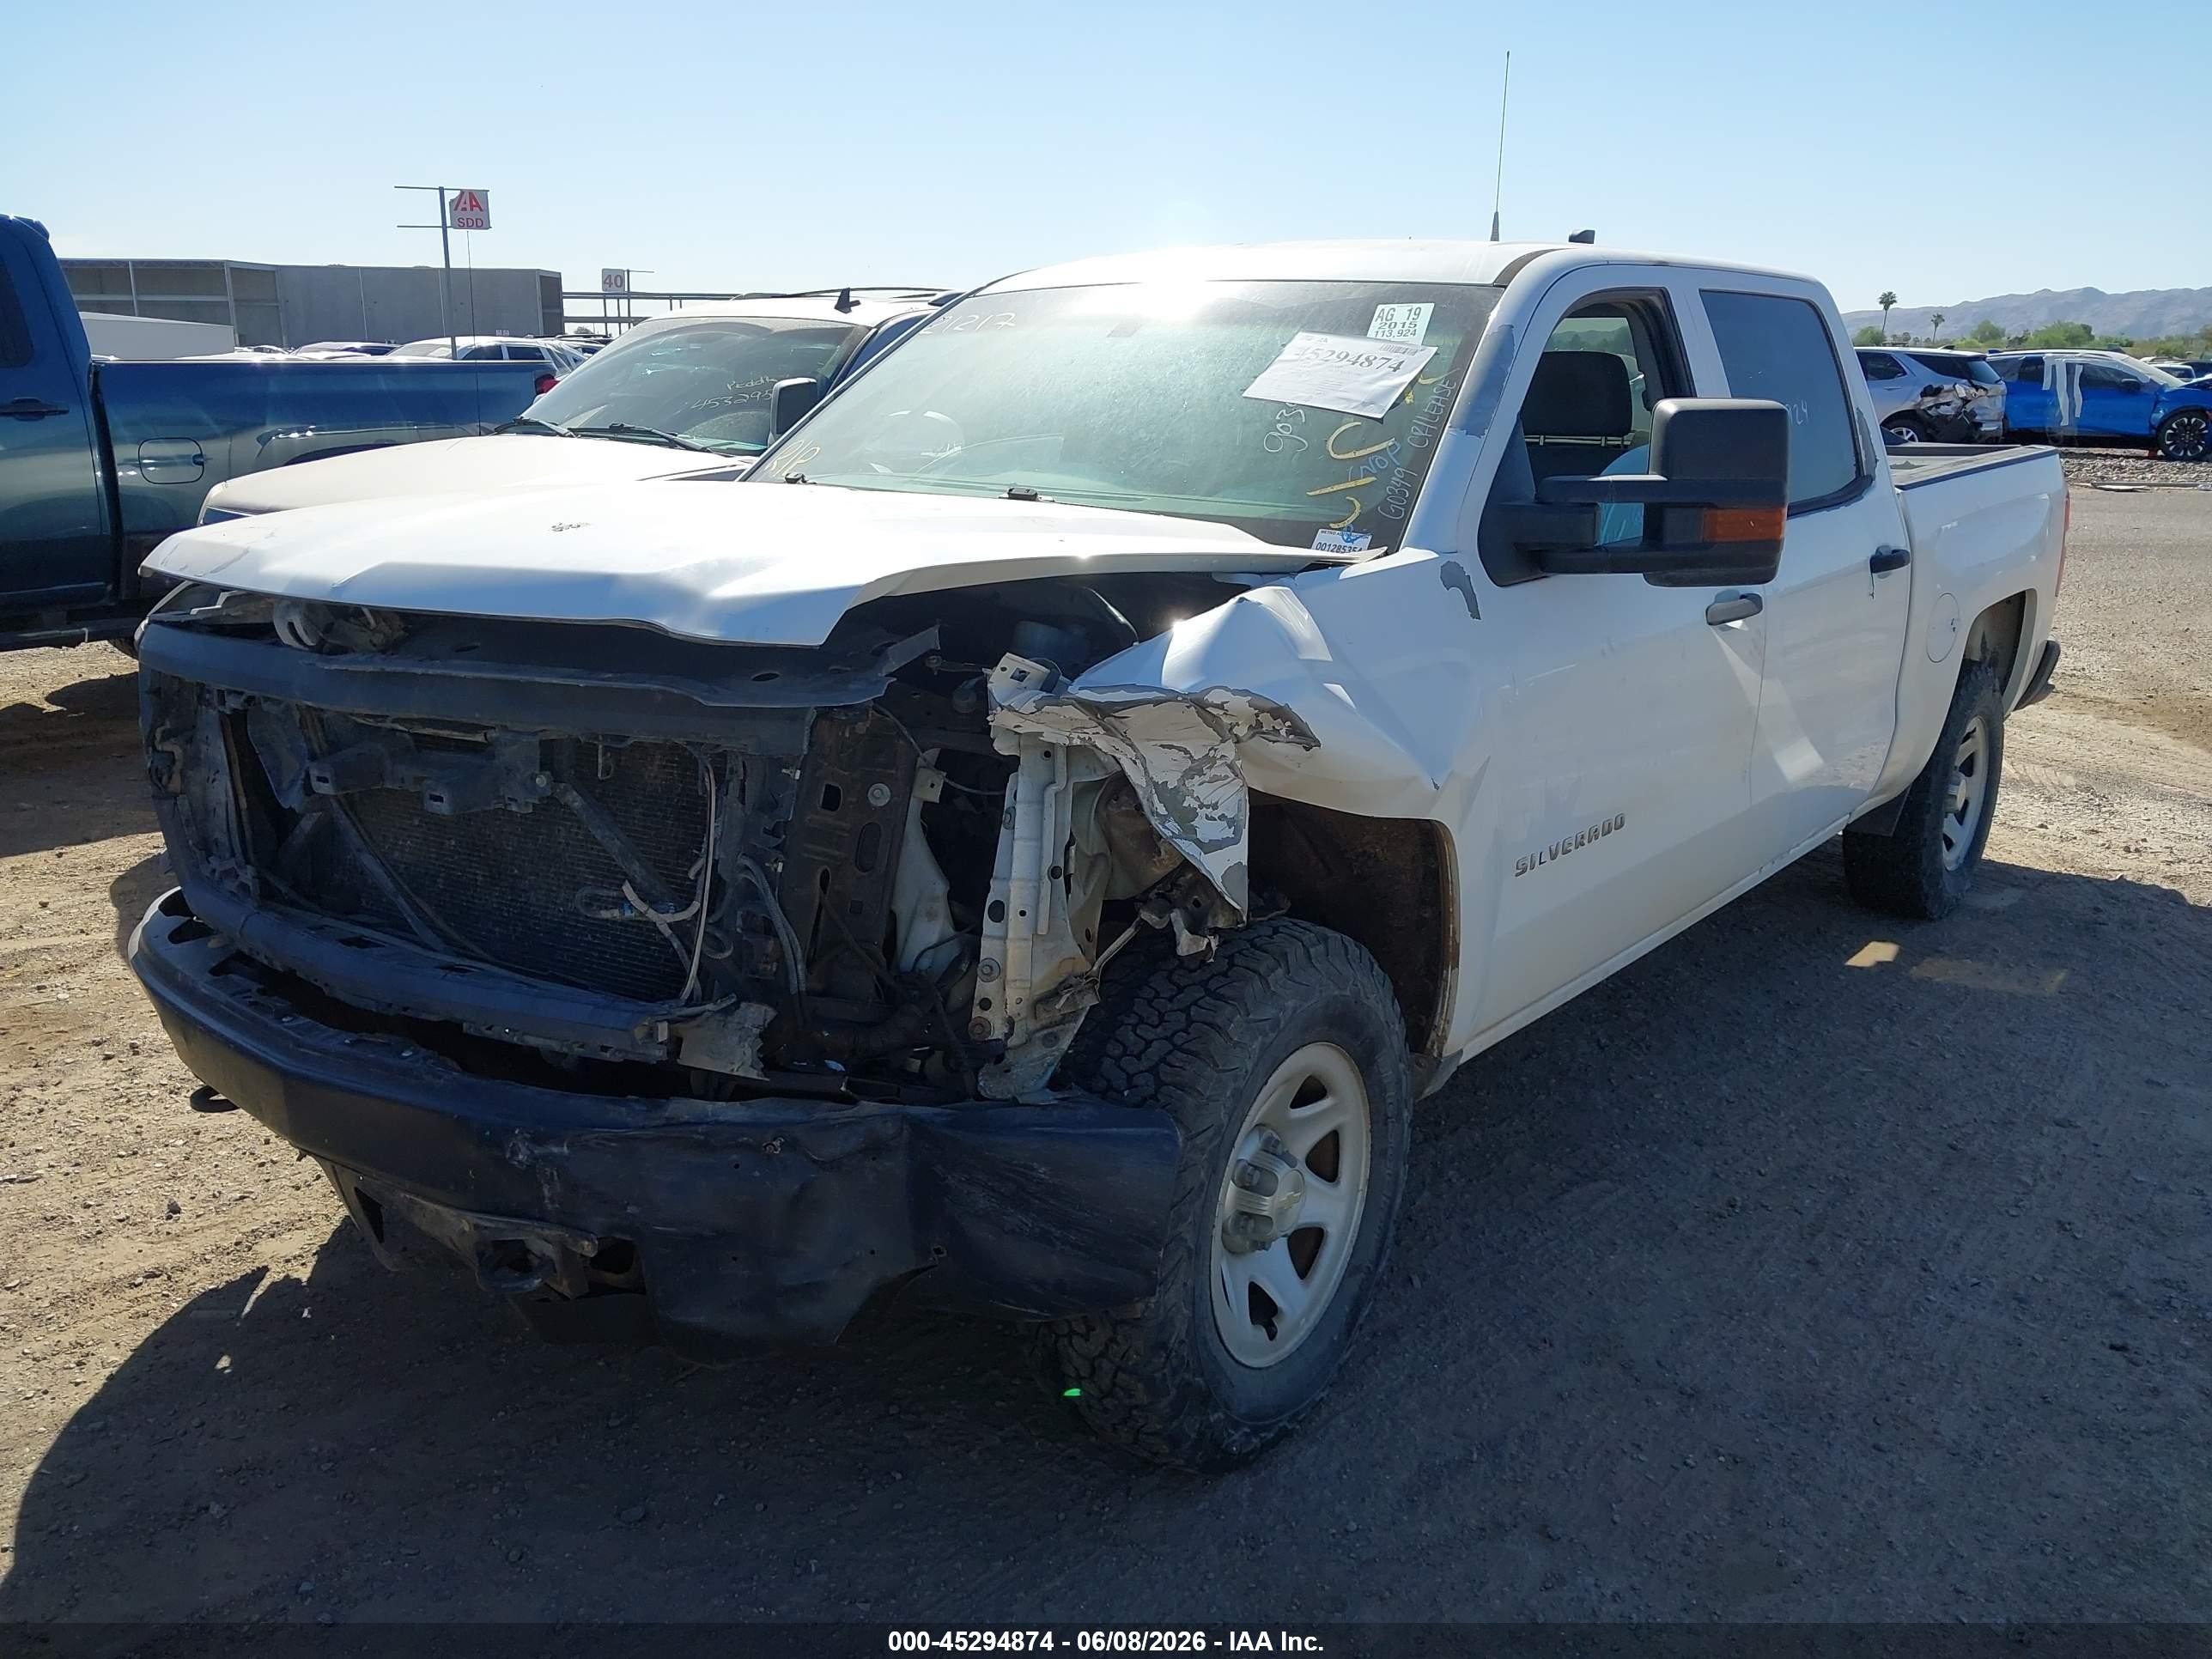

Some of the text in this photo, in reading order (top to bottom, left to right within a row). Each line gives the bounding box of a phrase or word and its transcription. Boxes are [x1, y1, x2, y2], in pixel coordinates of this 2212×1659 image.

[457, 217, 483, 228] SDD
[604, 275, 623, 288] 40
[1375, 307, 1422, 322] AG 19
[1377, 321, 1417, 330] 2015
[1295, 347, 1406, 373] 45294874
[1263, 402, 1308, 453] 903
[1515, 813, 1626, 877] SILVERADO
